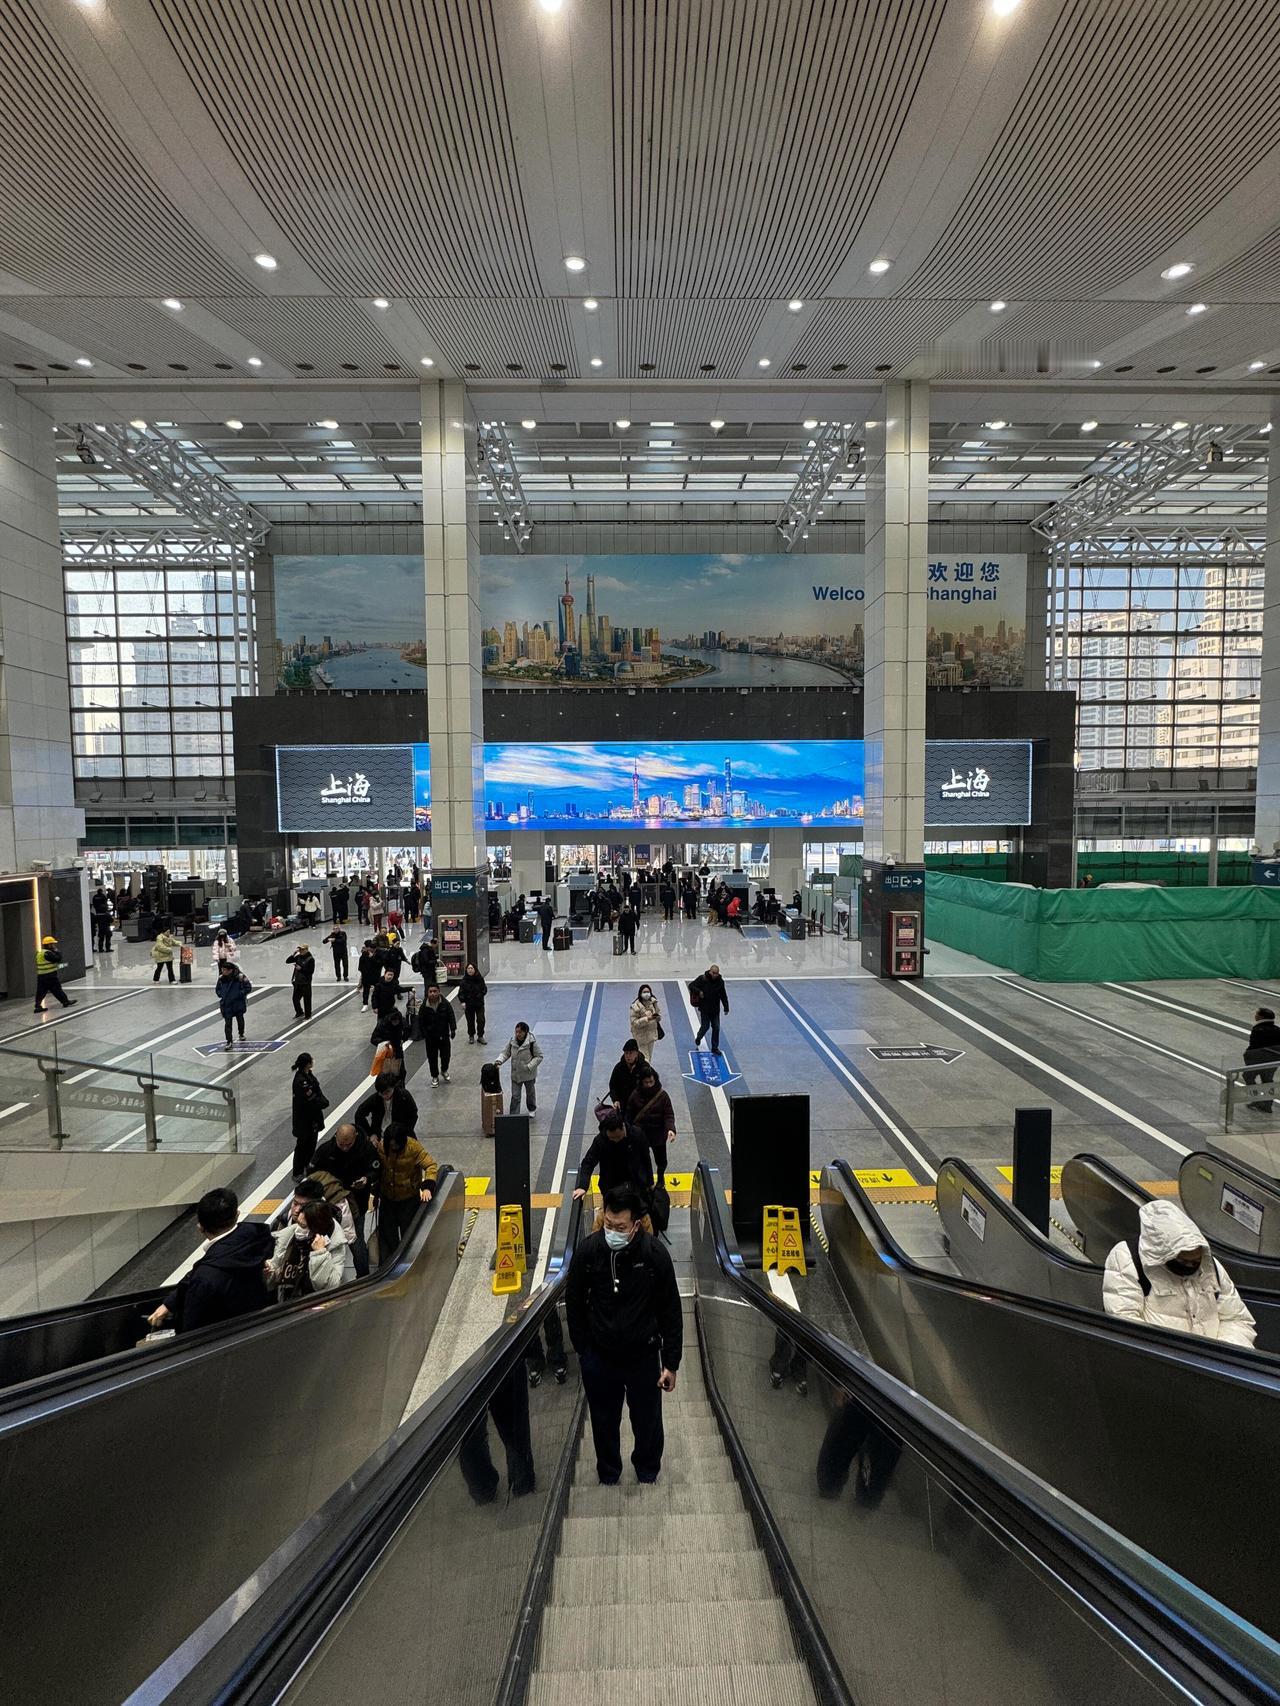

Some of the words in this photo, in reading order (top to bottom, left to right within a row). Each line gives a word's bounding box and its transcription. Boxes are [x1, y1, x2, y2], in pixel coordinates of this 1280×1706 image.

[928, 561, 1000, 583] 欢迎您
[942, 767, 990, 791] 上海
[321, 772, 370, 797] 上海
[942, 791, 970, 799] Shanghai
[321, 797, 351, 805] Shanghai
[885, 875, 899, 884] 出口
[434, 880, 449, 889] 出口
